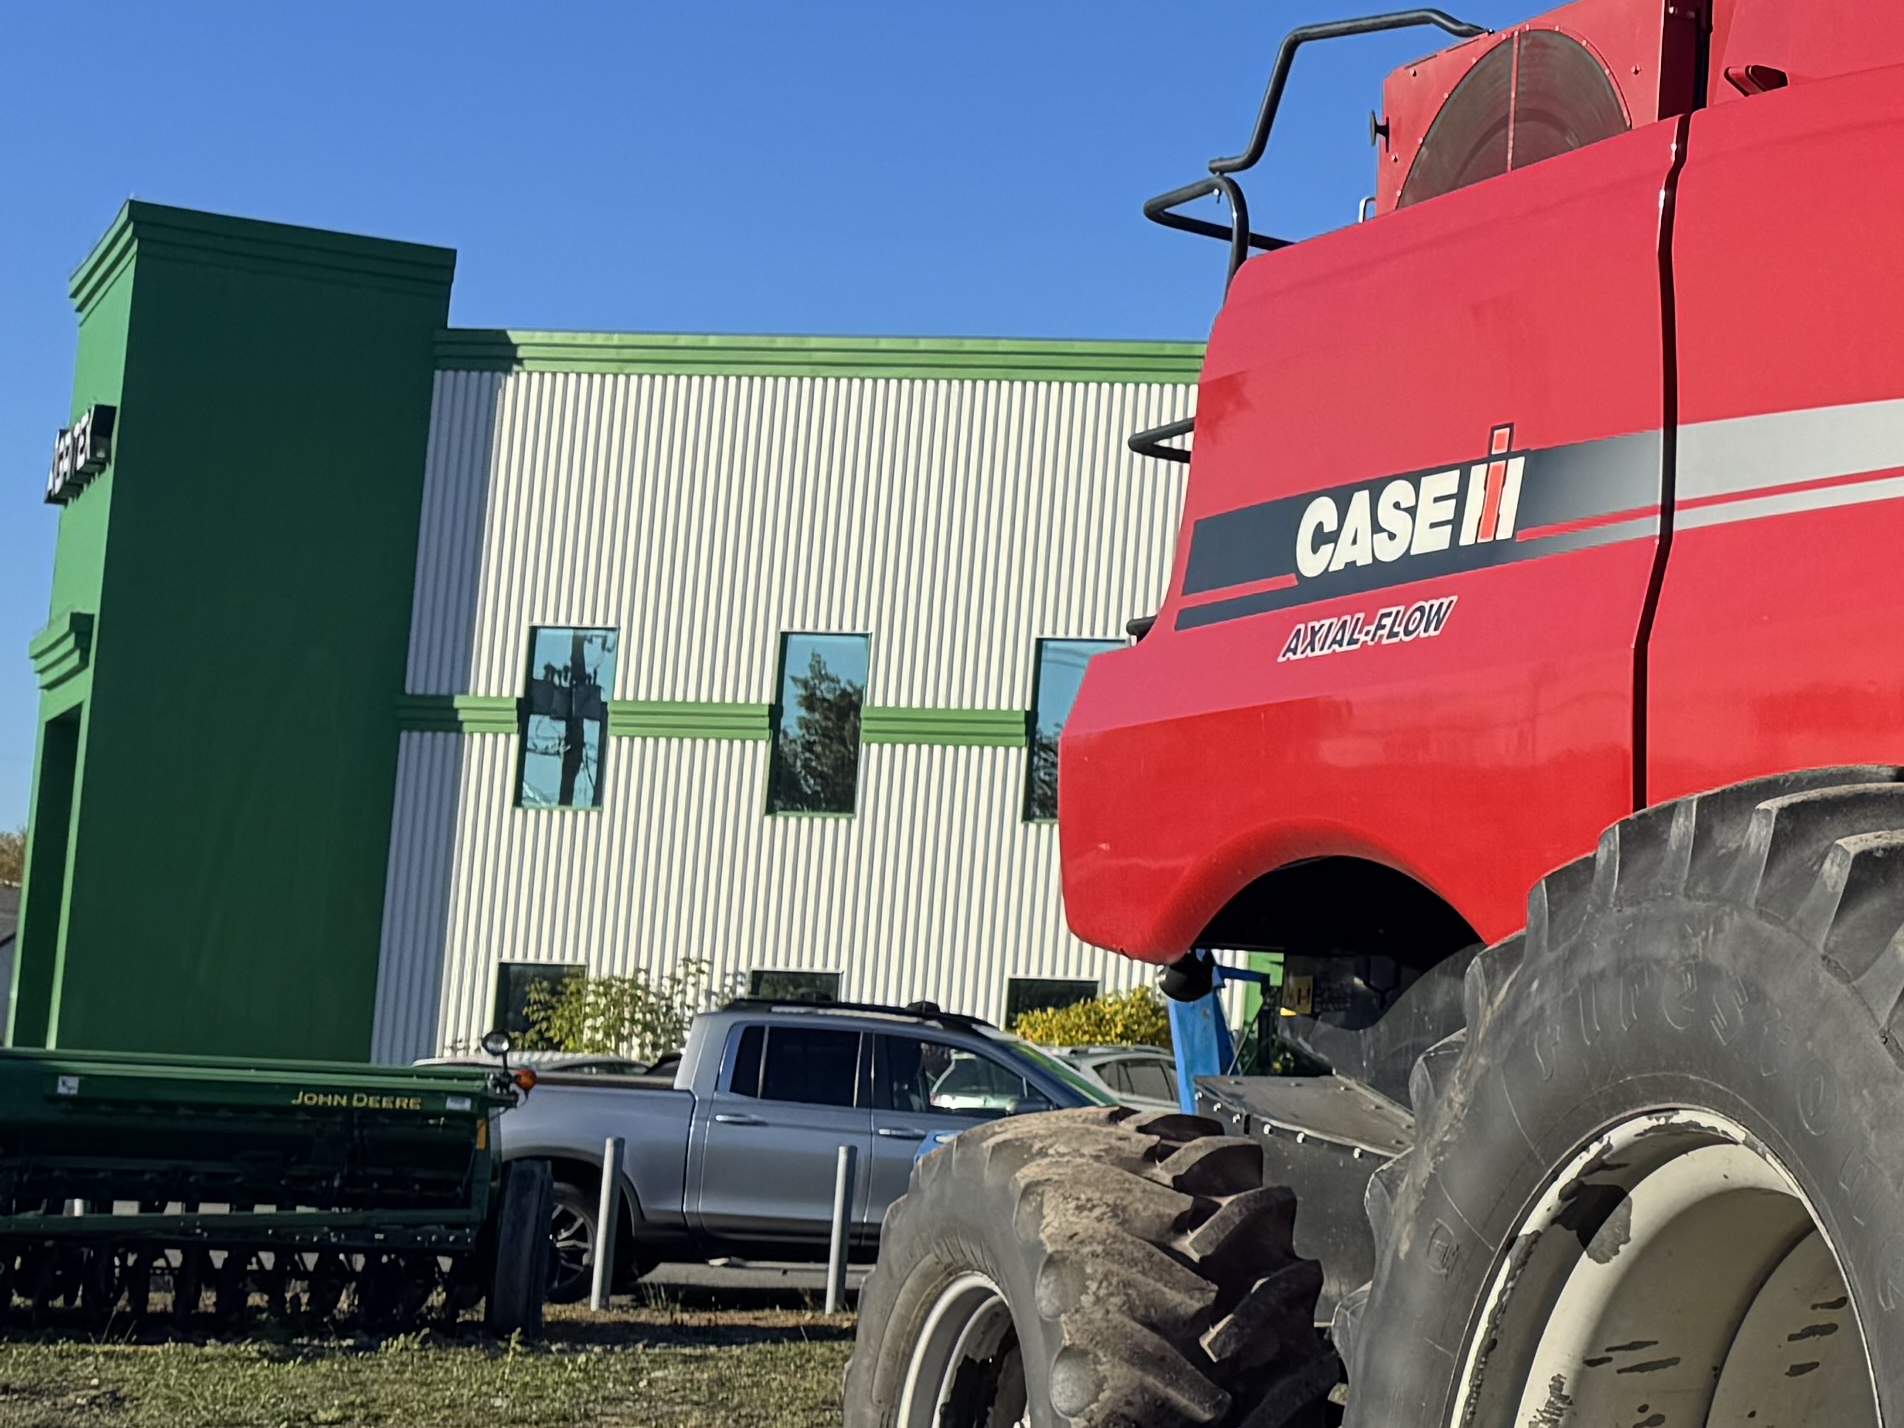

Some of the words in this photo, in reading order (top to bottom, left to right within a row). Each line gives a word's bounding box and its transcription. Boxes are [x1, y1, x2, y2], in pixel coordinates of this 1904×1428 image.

[1296, 469, 1460, 577] CASE
[1278, 596, 1457, 661] AXIAL-FLOW
[292, 1090, 347, 1107] JOHN
[353, 1092, 421, 1110] DEERE
